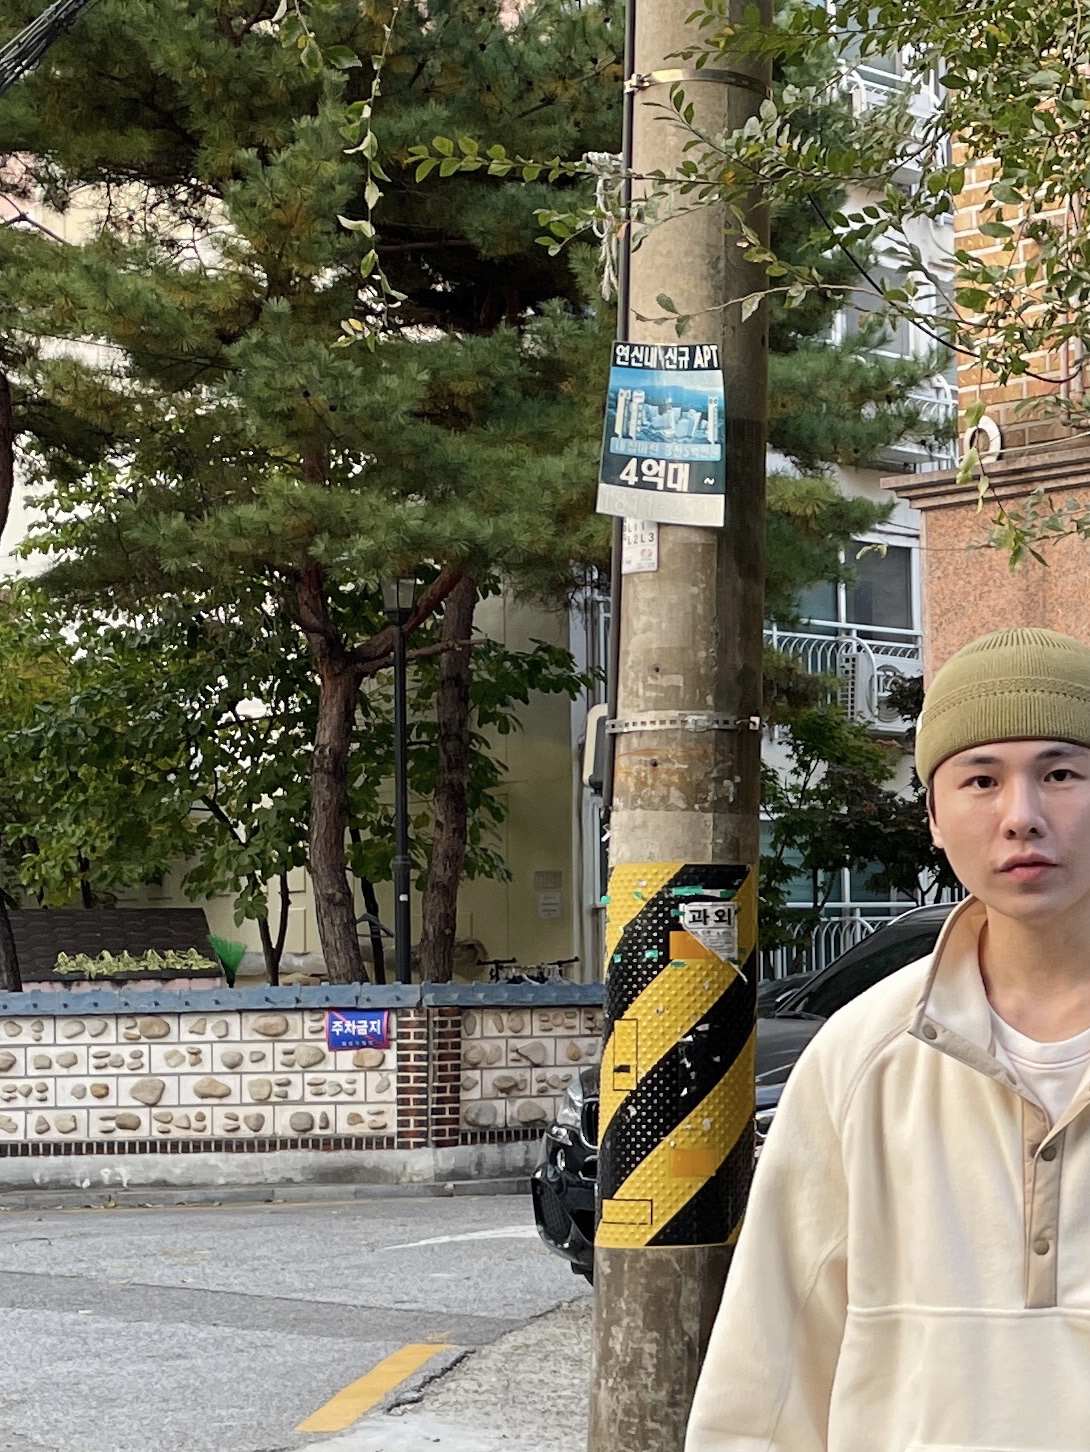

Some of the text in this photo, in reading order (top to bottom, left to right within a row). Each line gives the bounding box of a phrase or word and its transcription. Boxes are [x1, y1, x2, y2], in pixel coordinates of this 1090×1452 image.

[615, 344, 718, 369] 연신내 신규 APT
[619, 457, 690, 492] 4억대
[688, 907, 732, 926] 과외
[331, 1019, 382, 1036] 주차금지
